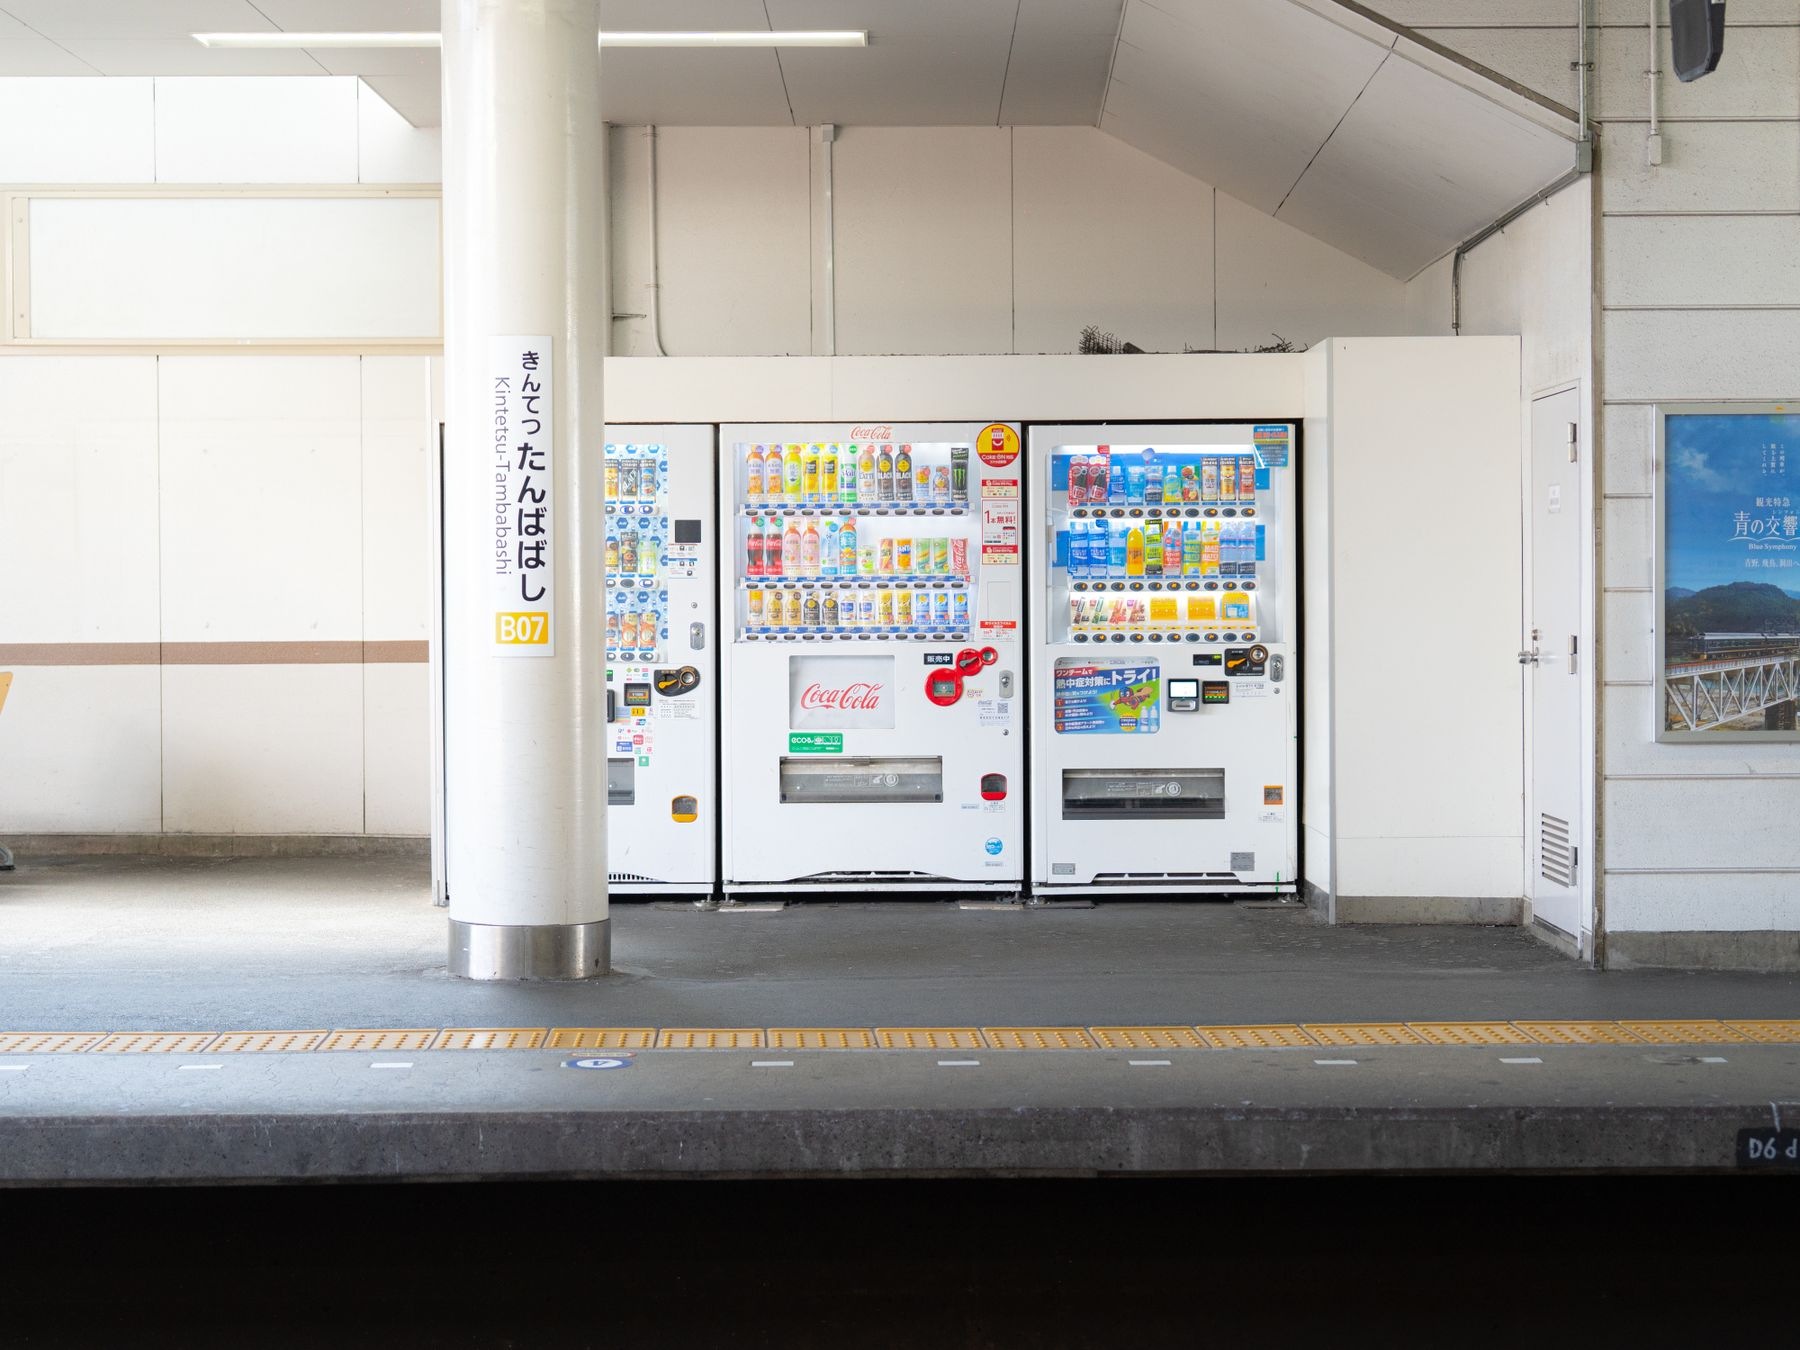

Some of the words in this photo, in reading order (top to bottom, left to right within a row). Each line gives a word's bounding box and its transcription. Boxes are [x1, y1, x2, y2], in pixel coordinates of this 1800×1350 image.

[494, 376, 512, 575] Kintetsu-Tambabashi
[1764, 543, 1797, 551] Symphony
[500, 616, 545, 641] B07
[927, 655, 950, 663] 販売中
[1056, 668, 1093, 677] ワンチームで
[800, 683, 885, 710] Coca-Cola
[1749, 1137, 1777, 1159] D6
